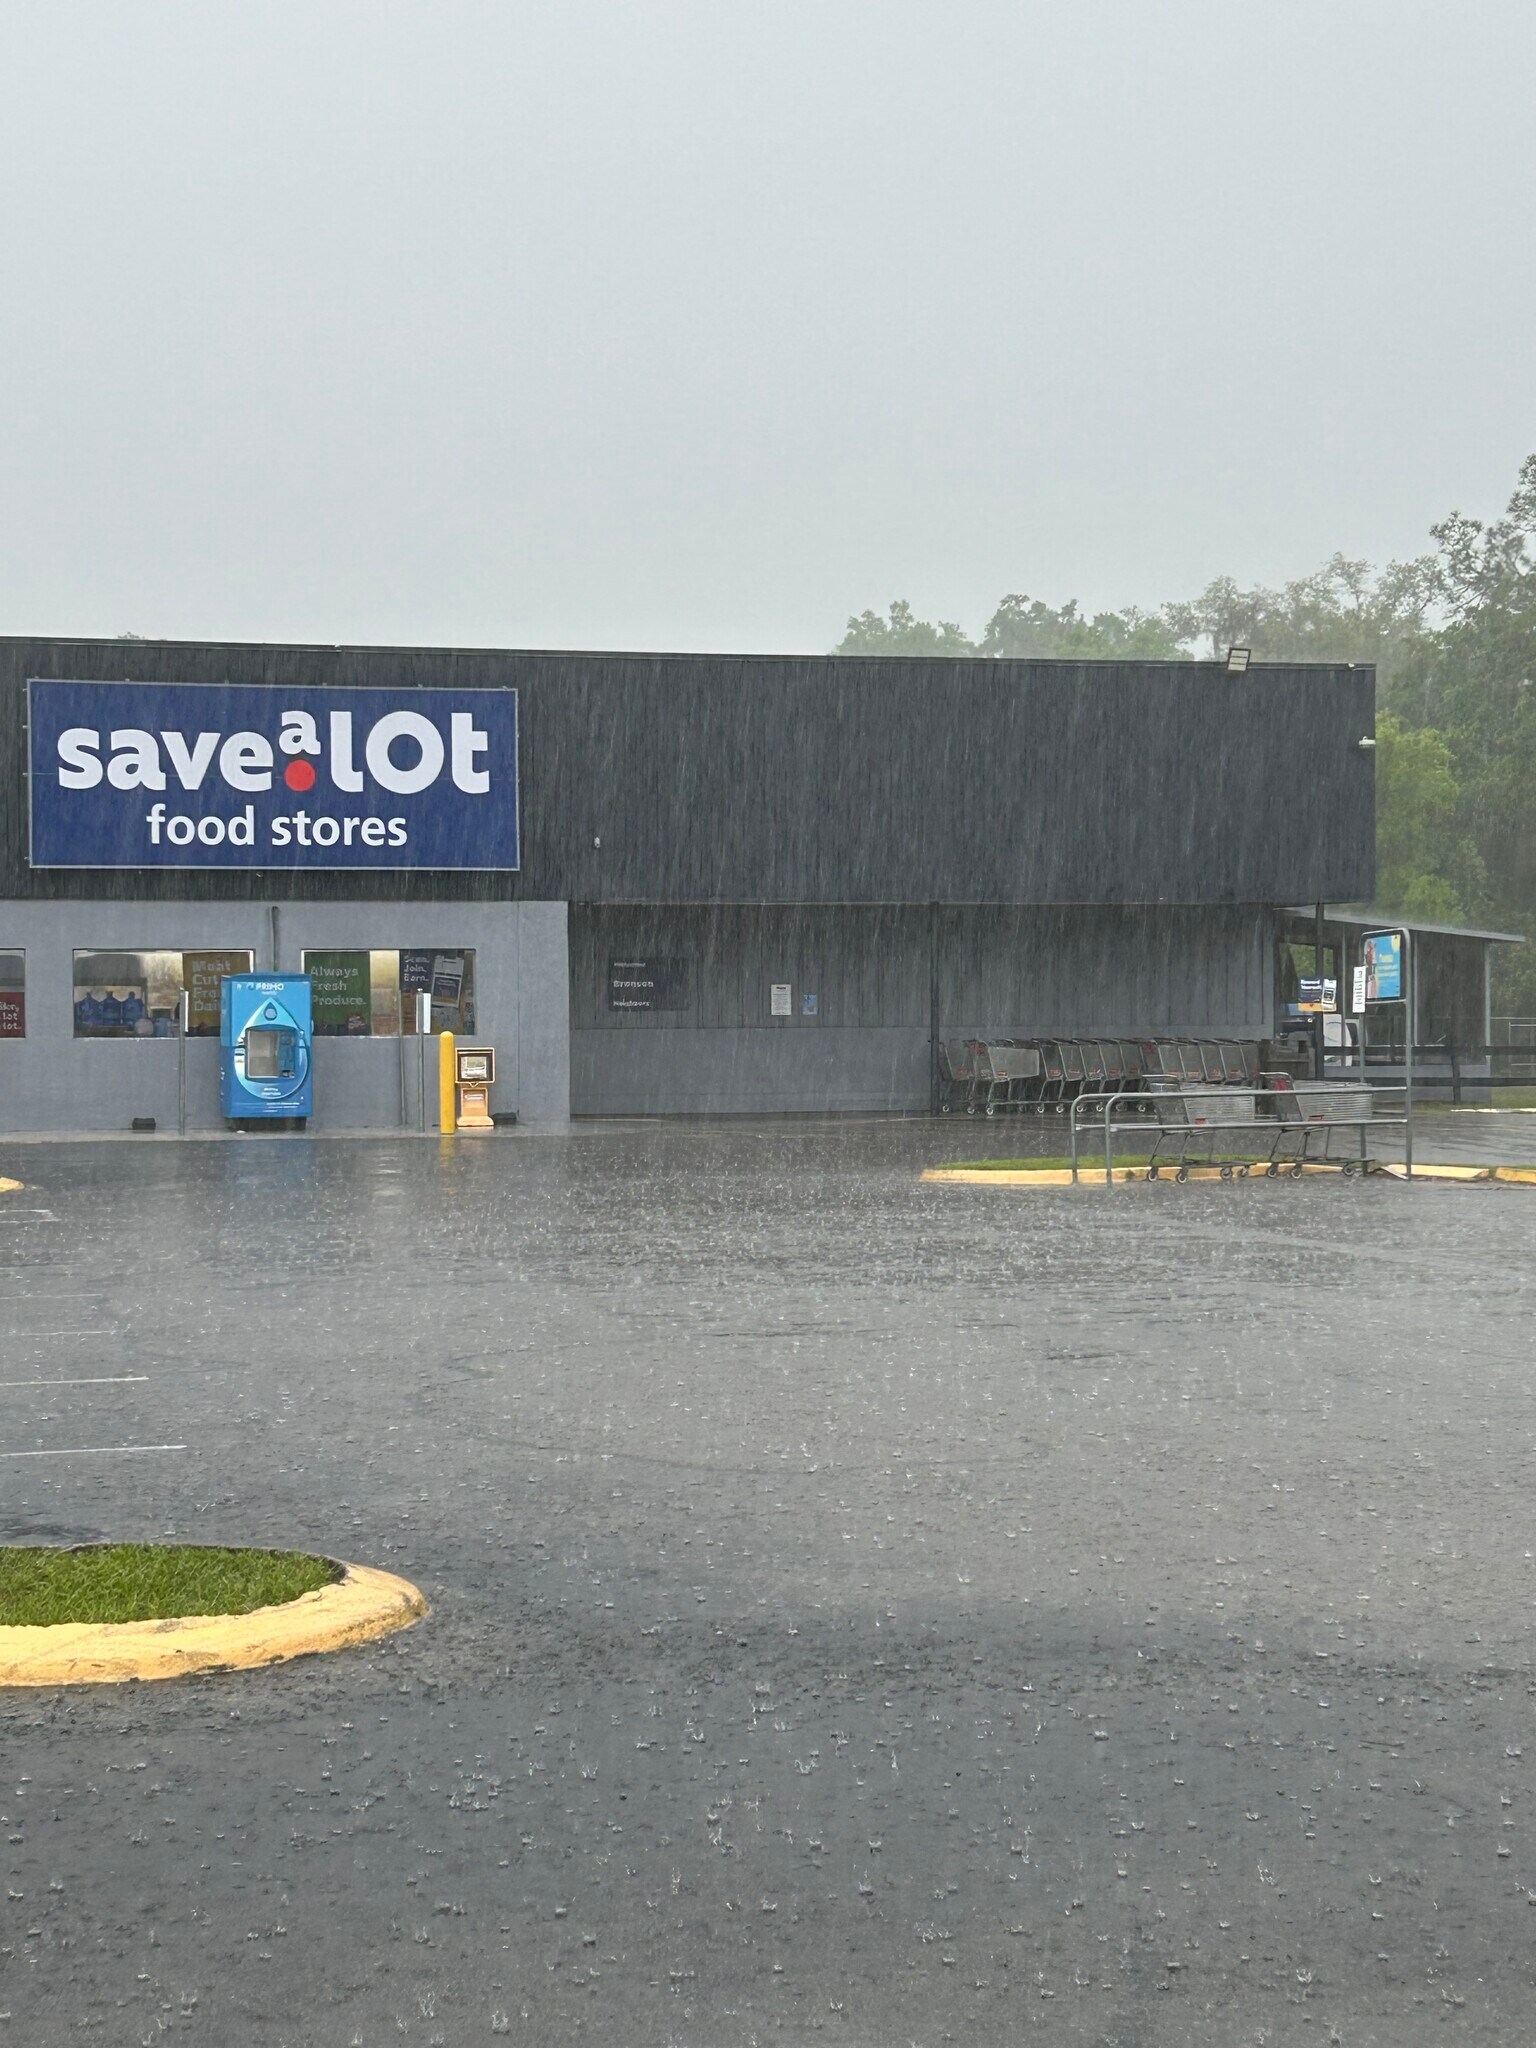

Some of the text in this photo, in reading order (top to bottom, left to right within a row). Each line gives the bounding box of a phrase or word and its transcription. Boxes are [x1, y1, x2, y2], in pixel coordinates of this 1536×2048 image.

[57, 727, 274, 792] save
[278, 710, 321, 756] a
[146, 803, 408, 846] food stores
[311, 966, 359, 978] Always
